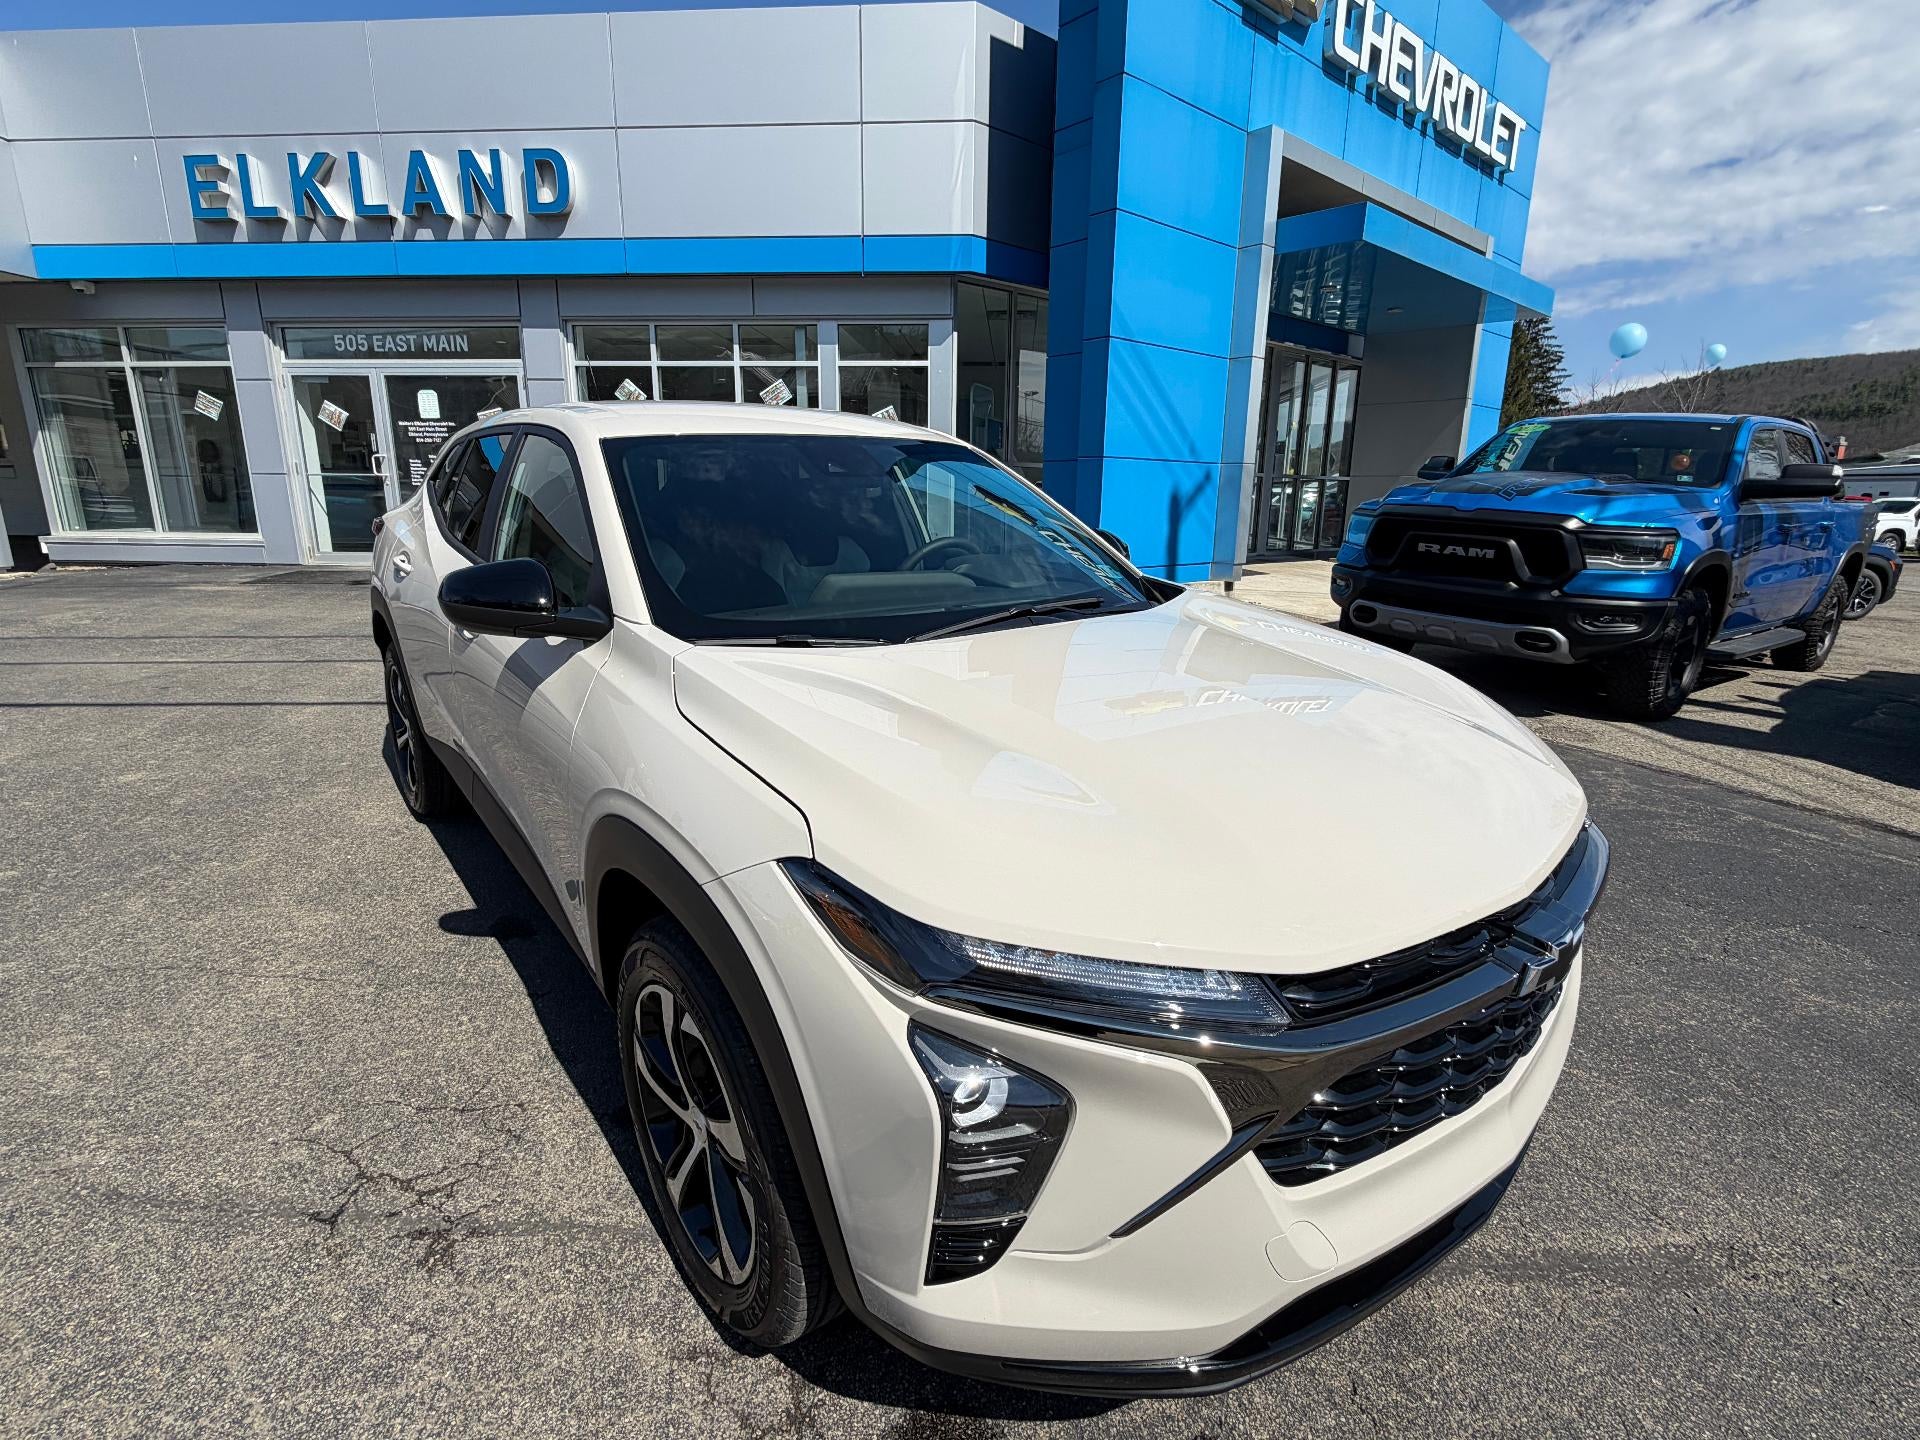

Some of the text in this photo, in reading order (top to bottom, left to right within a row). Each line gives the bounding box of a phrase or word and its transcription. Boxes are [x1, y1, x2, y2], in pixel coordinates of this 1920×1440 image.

[1333, 0, 1527, 172] CHEVROLET
[182, 147, 571, 221] ELKLAND
[333, 334, 469, 353] 505 EAST MAIN
[1418, 542, 1496, 559] RAM
